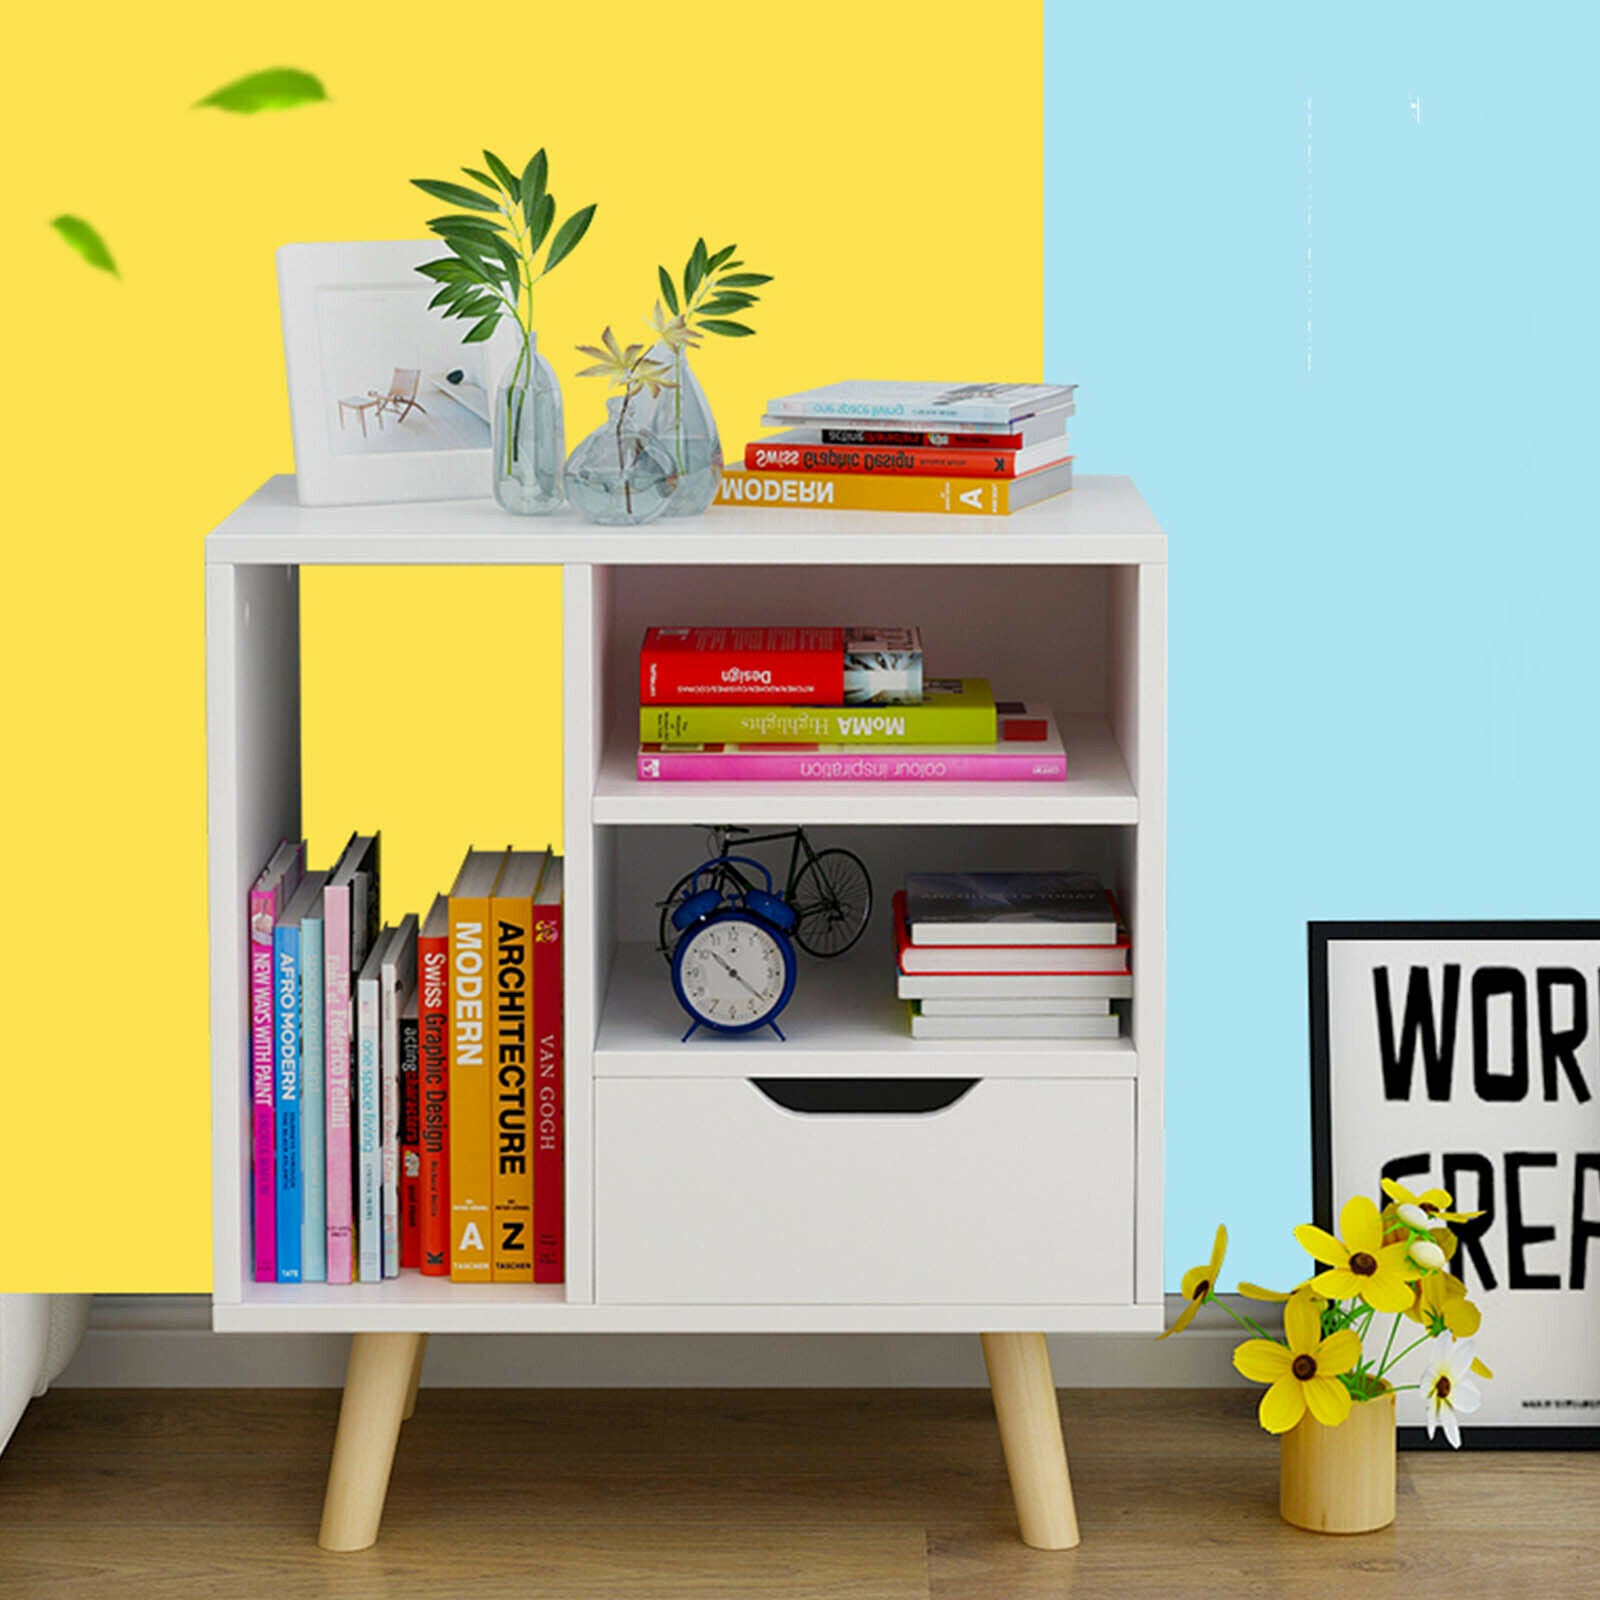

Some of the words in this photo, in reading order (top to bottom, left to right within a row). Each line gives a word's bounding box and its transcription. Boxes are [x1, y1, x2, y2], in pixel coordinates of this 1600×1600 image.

[720, 667, 772, 685] Design
[741, 714, 830, 736] Highlights
[836, 715, 906, 736] MoMA
[800, 759, 890, 777] inspiration
[897, 760, 947, 776] colour
[254, 953, 271, 983] NEW
[280, 953, 294, 1010] AFRO
[424, 952, 446, 1009] Swiss
[254, 984, 271, 1025] WAYS
[455, 921, 483, 1066] MODERN
[255, 1026, 272, 1063] WITH
[330, 1008, 350, 1074] Federico
[420, 1013, 447, 1086] Graphic
[498, 920, 526, 1175] ARCHITECTURE
[1372, 963, 1600, 1104] WOR
[281, 1013, 296, 1100] MODERN
[539, 1034, 555, 1081] VAN
[255, 1064, 272, 1107] PAINT
[330, 1076, 351, 1129] Fellini
[360, 1069, 376, 1109] space
[360, 1111, 378, 1154] living
[422, 1089, 447, 1154] Design
[539, 1086, 556, 1151] GOGH
[459, 1222, 485, 1251] A
